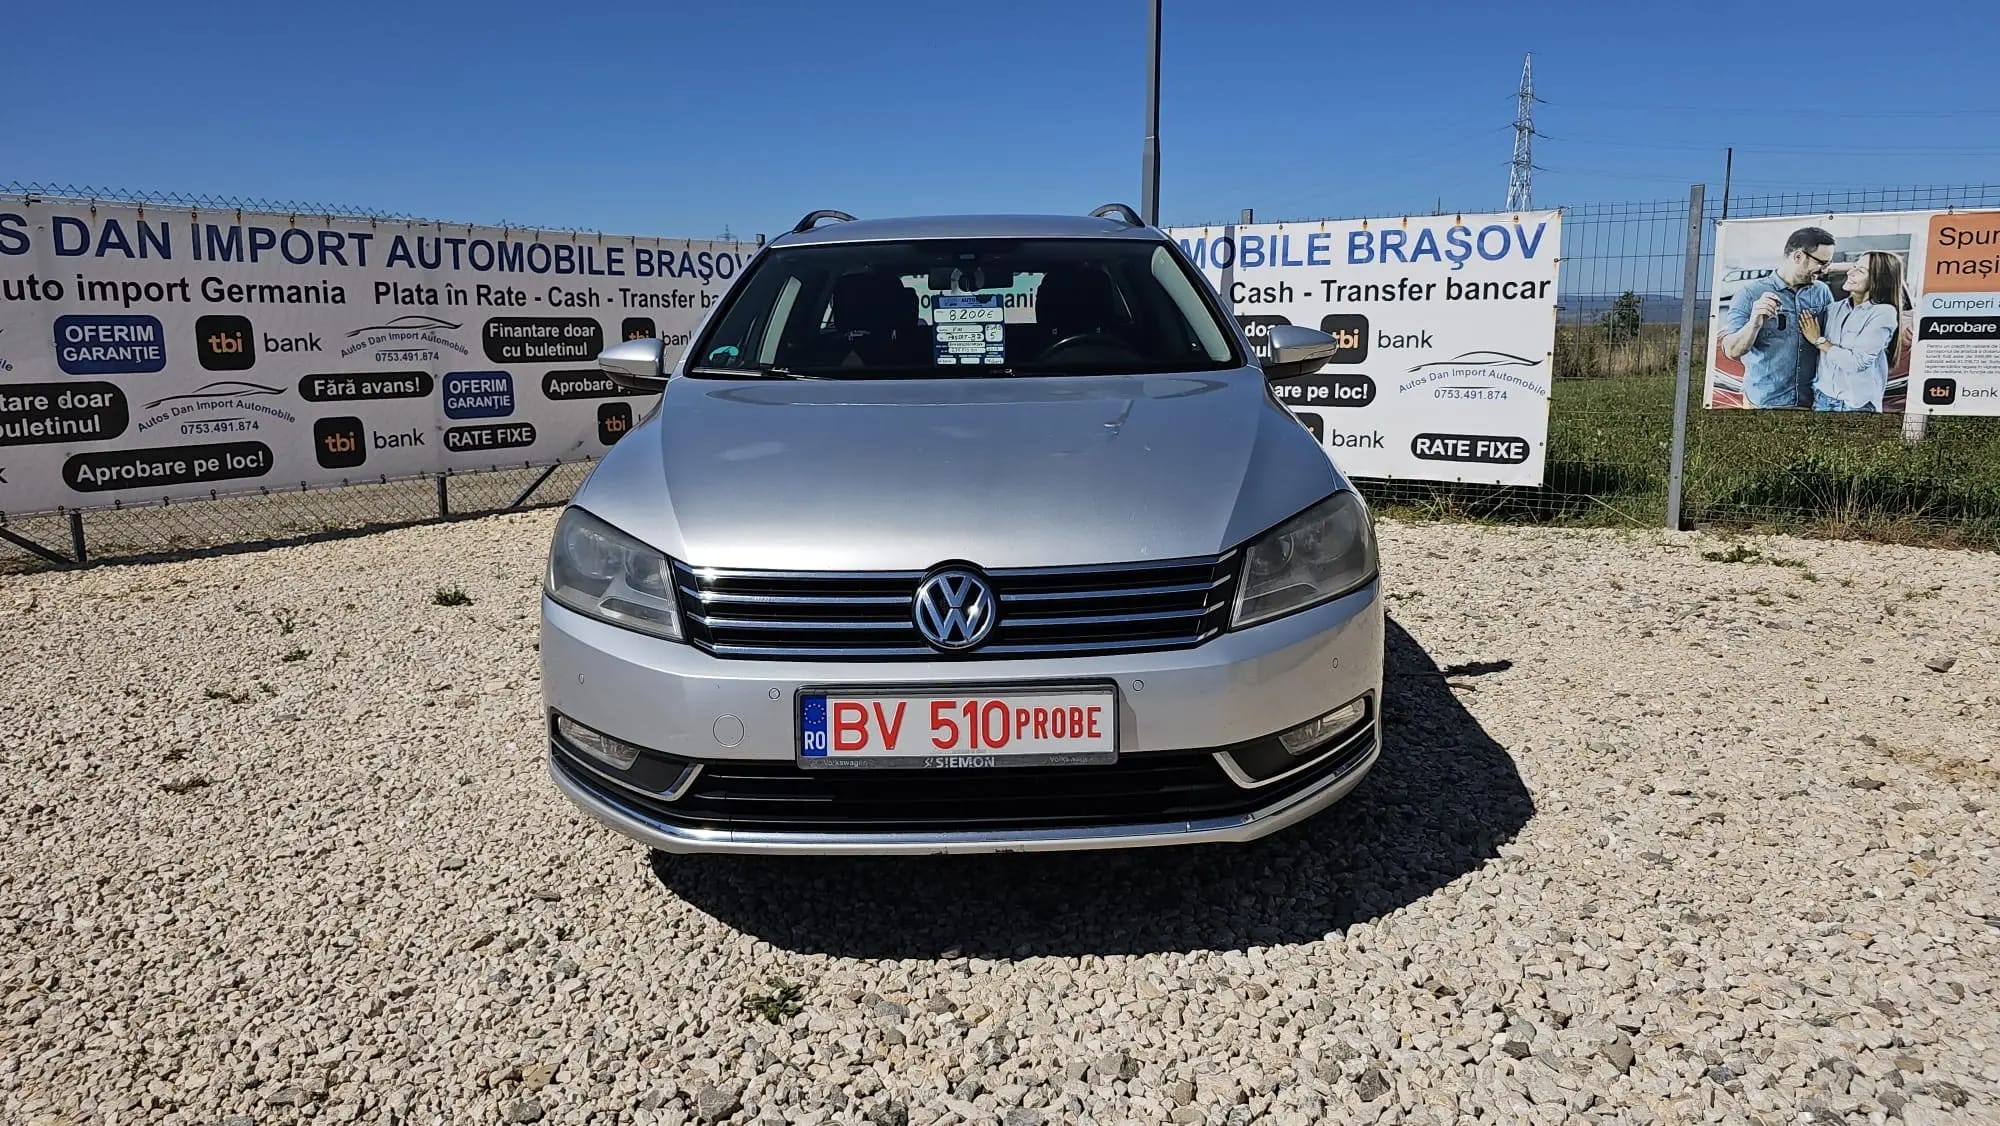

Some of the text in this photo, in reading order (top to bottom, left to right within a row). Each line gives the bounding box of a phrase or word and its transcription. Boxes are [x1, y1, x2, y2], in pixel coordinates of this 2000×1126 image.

[52, 216, 172, 259] DAN
[191, 222, 373, 267] IMPORT
[387, 234, 625, 276] AUTOMOBILE
[77, 274, 190, 308] import
[201, 276, 346, 304] Germania
[375, 282, 437, 307] Plata
[446, 284, 468, 306] în
[476, 284, 527, 307] Rate
[548, 287, 600, 308] Cash
[619, 288, 695, 309] Transfer
[1230, 280, 1293, 303] Cash
[1321, 278, 1436, 302] Transfer
[1446, 277, 1551, 300] bancar
[1932, 298, 1994, 311] Cumperi
[65, 325, 154, 343] OFERIM
[489, 321, 595, 339] Finantare doar
[1928, 321, 1997, 335] Aprobare
[208, 331, 322, 354] tbi bank
[341, 332, 469, 358] Autos Dan Import Automobile
[502, 340, 587, 358] cu buletinul
[1378, 330, 1433, 349] bank
[375, 351, 440, 362] 0753.491.874
[314, 378, 420, 396] Fără avans!
[449, 379, 507, 394] OFERIM
[549, 379, 613, 396] Aprobare
[1399, 368, 1546, 396] Autos Dan Import Automobile
[57, 390, 113, 409] doar
[1307, 386, 1329, 402] pe
[1334, 383, 1368, 399] loc!
[1434, 389, 1507, 400] 0753.491.874
[1929, 386, 1998, 398] tbi bank
[137, 400, 295, 432] Autos Dan Import Automobile
[605, 414, 626, 432] tbi
[180, 421, 259, 435] 0753.491.874
[325, 429, 425, 452] tbi bank
[448, 428, 532, 448] RATE FIXE
[1332, 429, 1385, 448] bank
[1416, 438, 1523, 459] RATE FIXE
[76, 450, 265, 486] Aprobare pe loc!
[804, 699, 1102, 751] RO BV 510 PROBE
